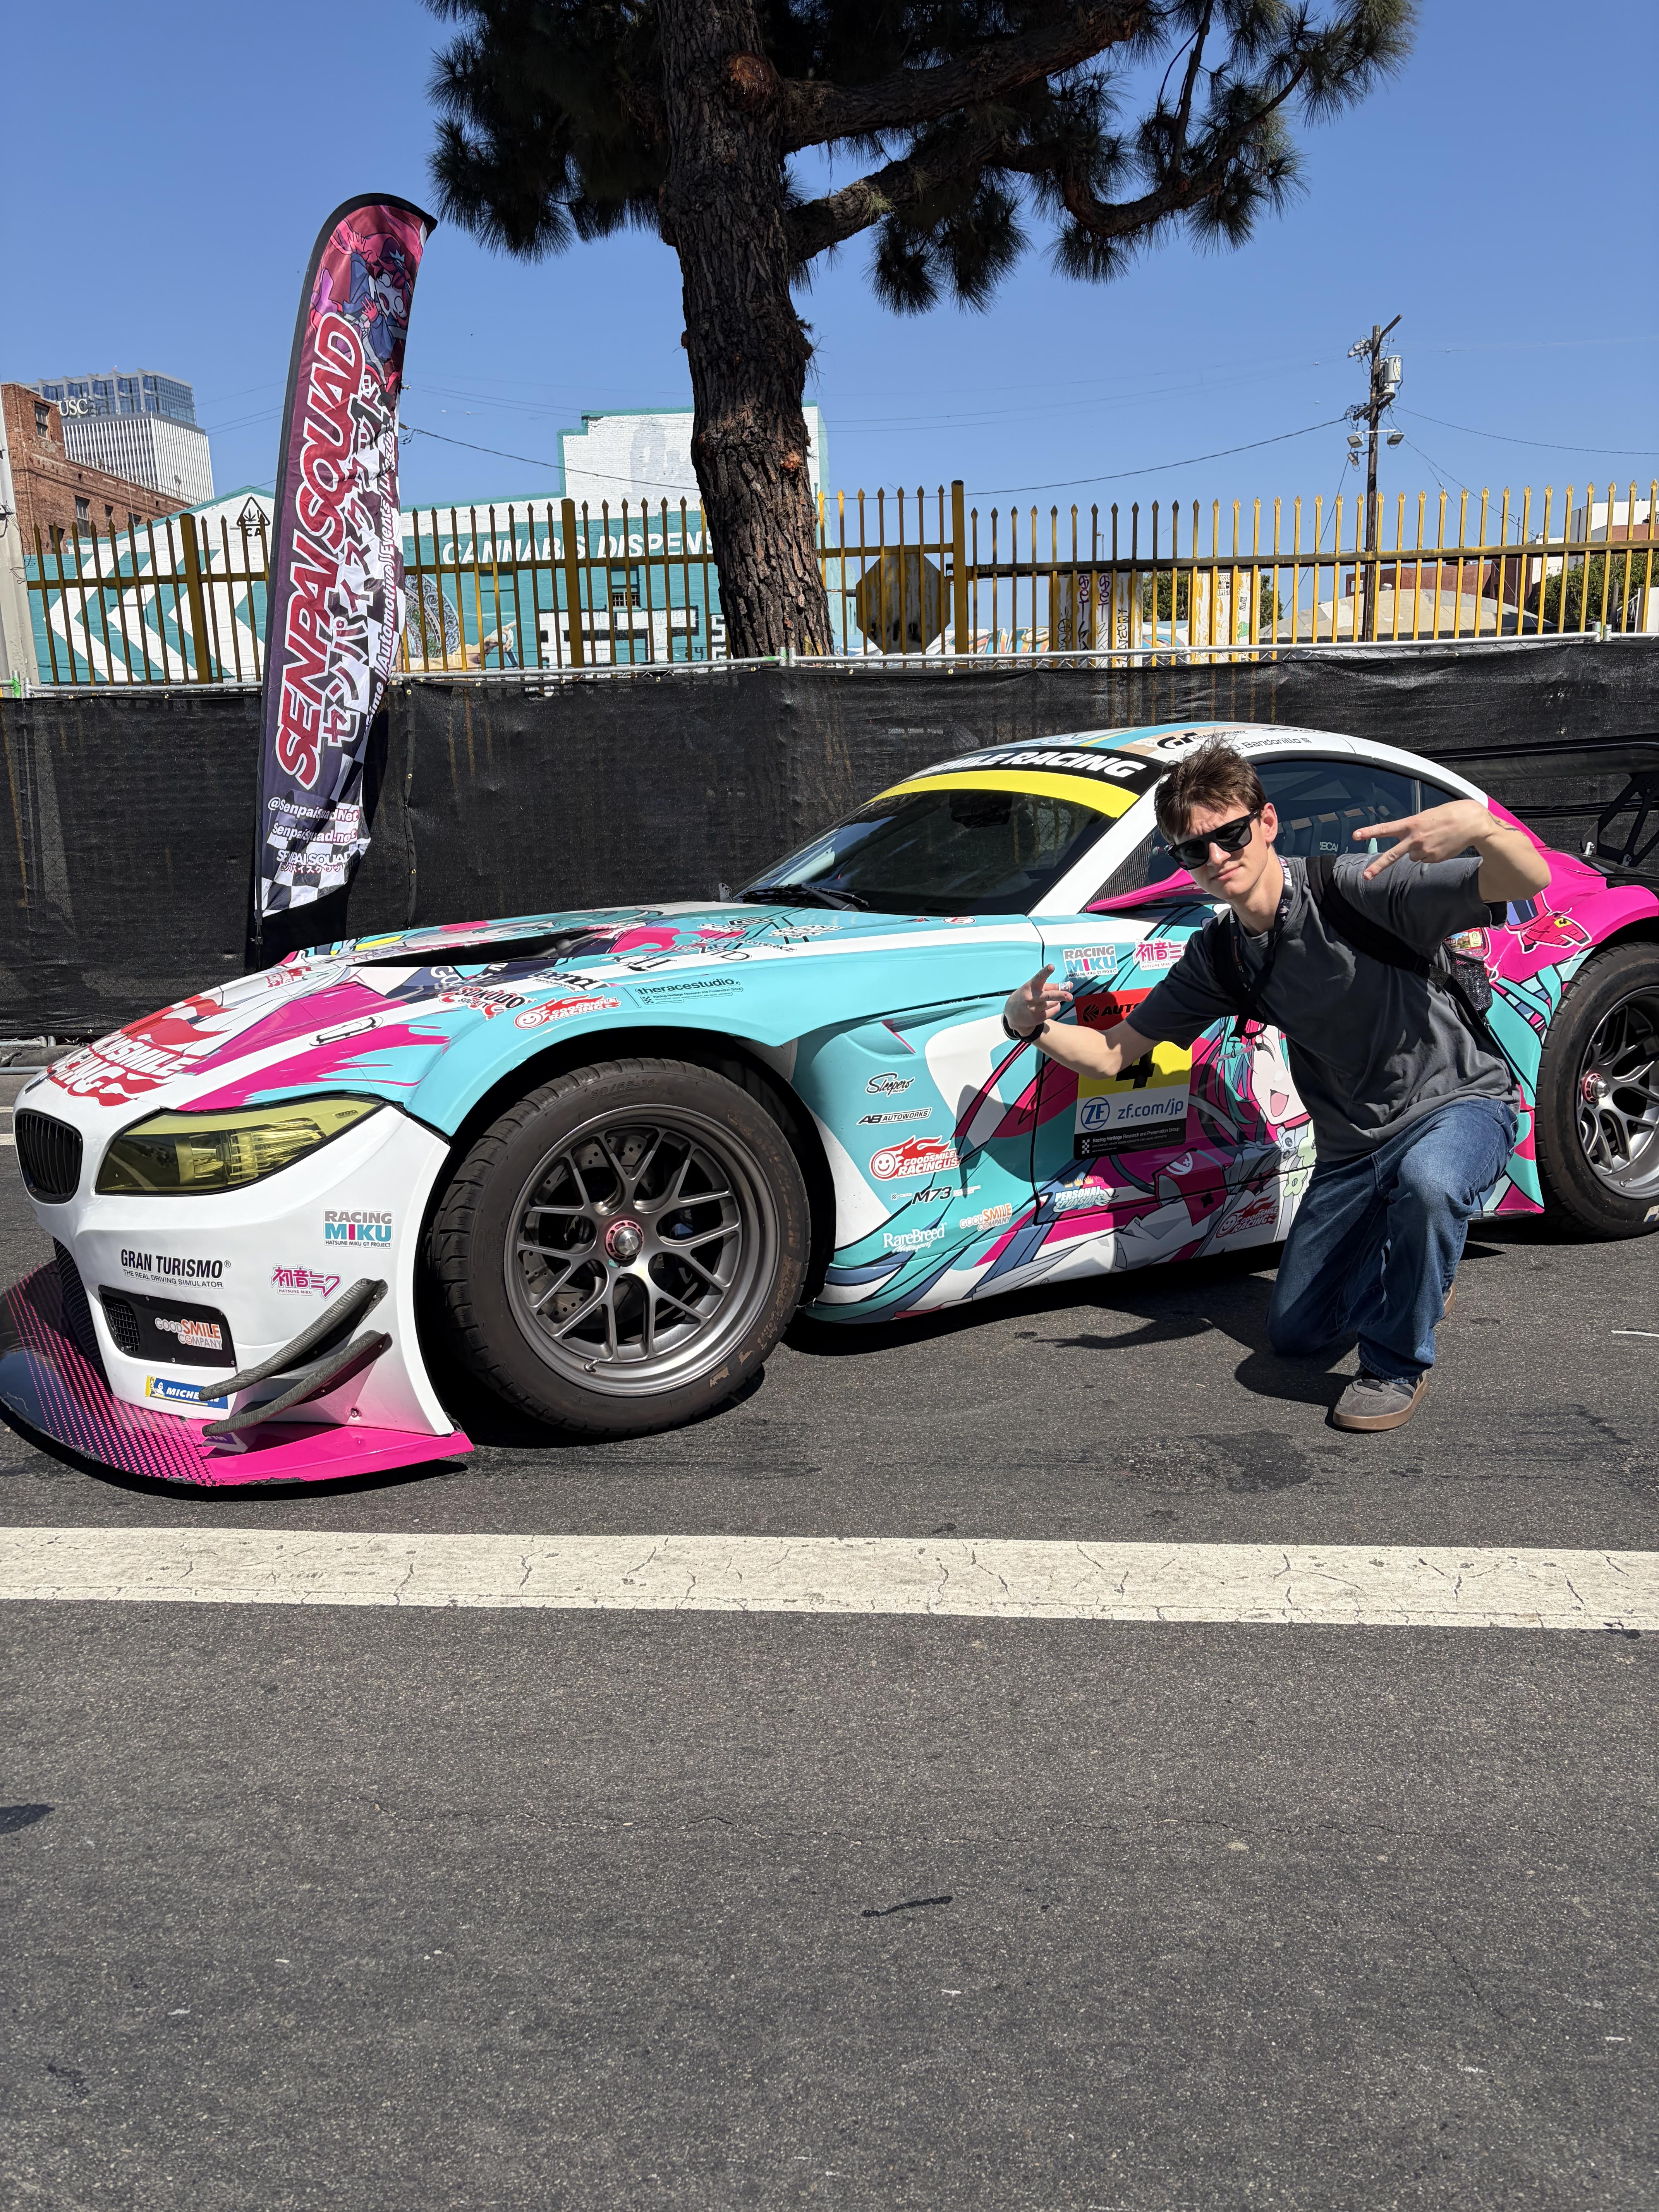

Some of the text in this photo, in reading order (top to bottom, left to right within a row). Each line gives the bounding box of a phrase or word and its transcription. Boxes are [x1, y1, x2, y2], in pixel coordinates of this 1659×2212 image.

[57, 398, 88, 416] USC
[1000, 752, 1147, 778] RACING
[1064, 945, 1115, 960] RACING
[1065, 955, 1117, 974] MIKU
[638, 978, 739, 994] theracestudio.
[455, 988, 525, 1008] SOKUDO
[457, 998, 491, 1008] SOCIETY
[551, 998, 617, 1015] GOODSMILE
[548, 1004, 603, 1021] RACING
[1115, 1049, 1156, 1089] 4
[866, 1072, 915, 1096] Sleepers
[857, 1110, 928, 1124] AB AUTOWORKS
[1084, 1097, 1184, 1125] ZF zf.com/jp
[903, 1150, 956, 1166] GOODSMILE
[898, 1161, 942, 1176] RACING
[912, 1186, 953, 1205] M73
[1054, 1186, 1101, 1203] PERSONAL
[1055, 1194, 1104, 1209] SPONSORS
[325, 1211, 392, 1224] RACING
[1233, 1214, 1269, 1232] RACING
[1240, 1207, 1278, 1224] GOODSMILE
[325, 1223, 392, 1242] MIKU
[883, 1224, 945, 1248] RareBreed
[121, 1249, 152, 1272] GRAN
[123, 1269, 223, 1288] THE REAL DRIVING SIMULATOR
[272, 1266, 340, 1298] 初音ミク
